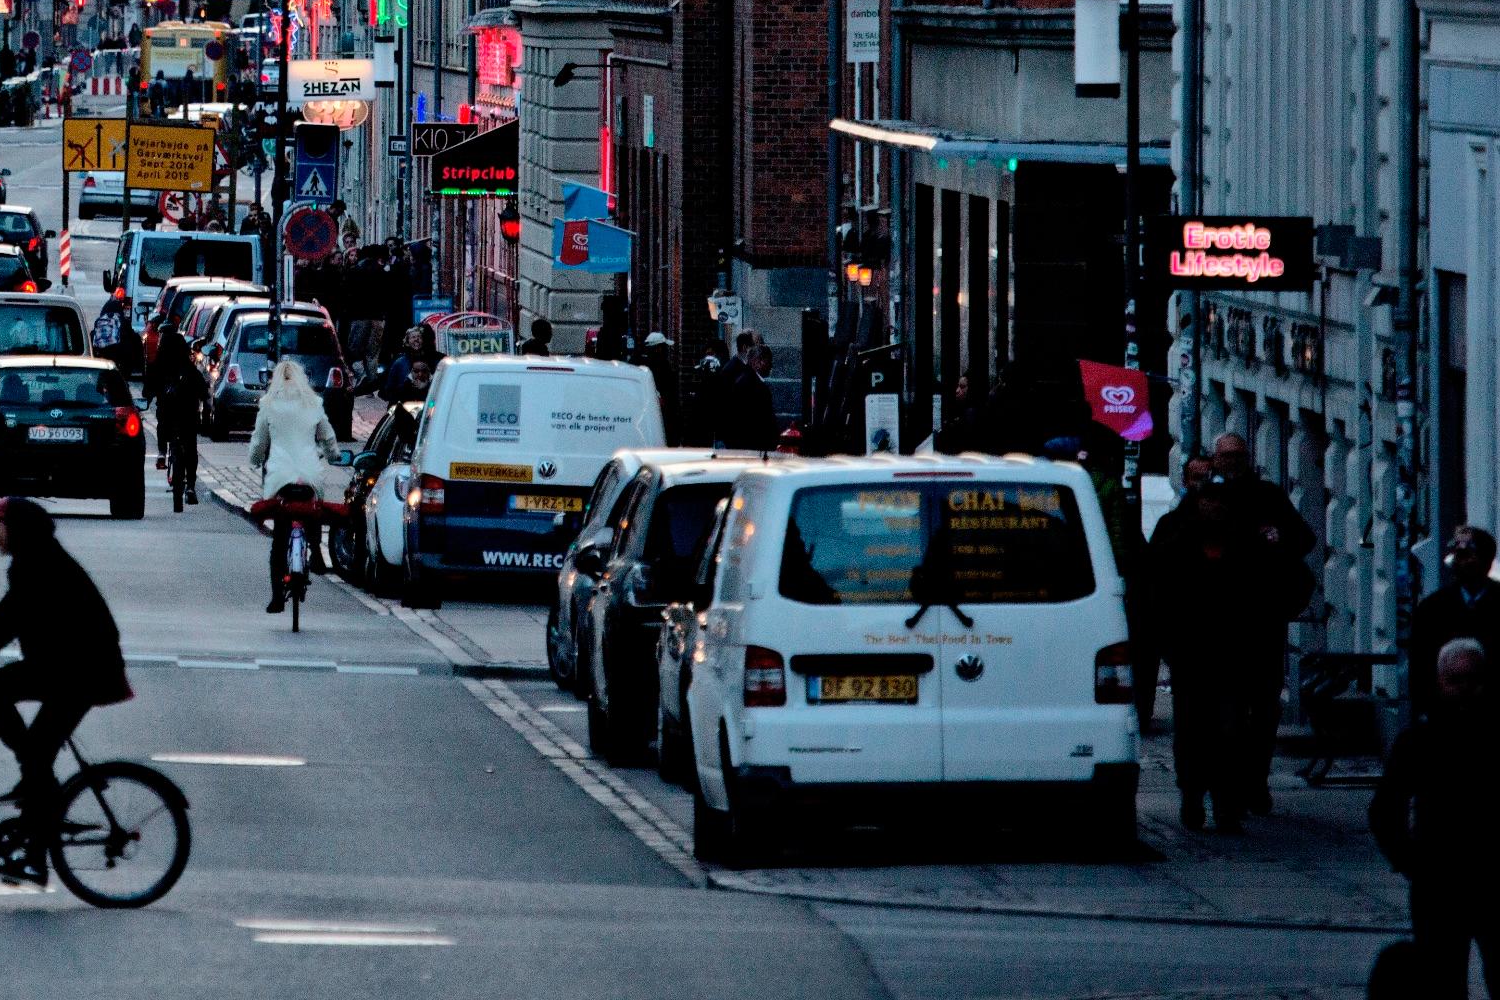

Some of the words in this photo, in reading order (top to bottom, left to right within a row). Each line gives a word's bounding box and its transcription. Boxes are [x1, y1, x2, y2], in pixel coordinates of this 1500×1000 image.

[303, 81, 360, 93] SHEZAN
[133, 138, 189, 150] Vejarbejde
[196, 143, 209, 152] på
[137, 150, 204, 161] Gasværksvej
[169, 161, 194, 170] 2014
[137, 170, 160, 179] April
[442, 166, 516, 181] Stripclub
[1184, 222, 1271, 249] Erotic
[1171, 251, 1284, 282] Lifestyle
[457, 338, 503, 353] OPEN
[871, 372, 884, 387] P
[479, 412, 518, 424] RECO
[551, 412, 573, 421] RECO
[576, 412, 586, 421] de
[588, 414, 610, 422] beste
[613, 415, 632, 423] start
[569, 422, 581, 430] elk
[455, 465, 527, 478] WERKVERKEER
[864, 634, 884, 644] The
[941, 633, 967, 644] Food
